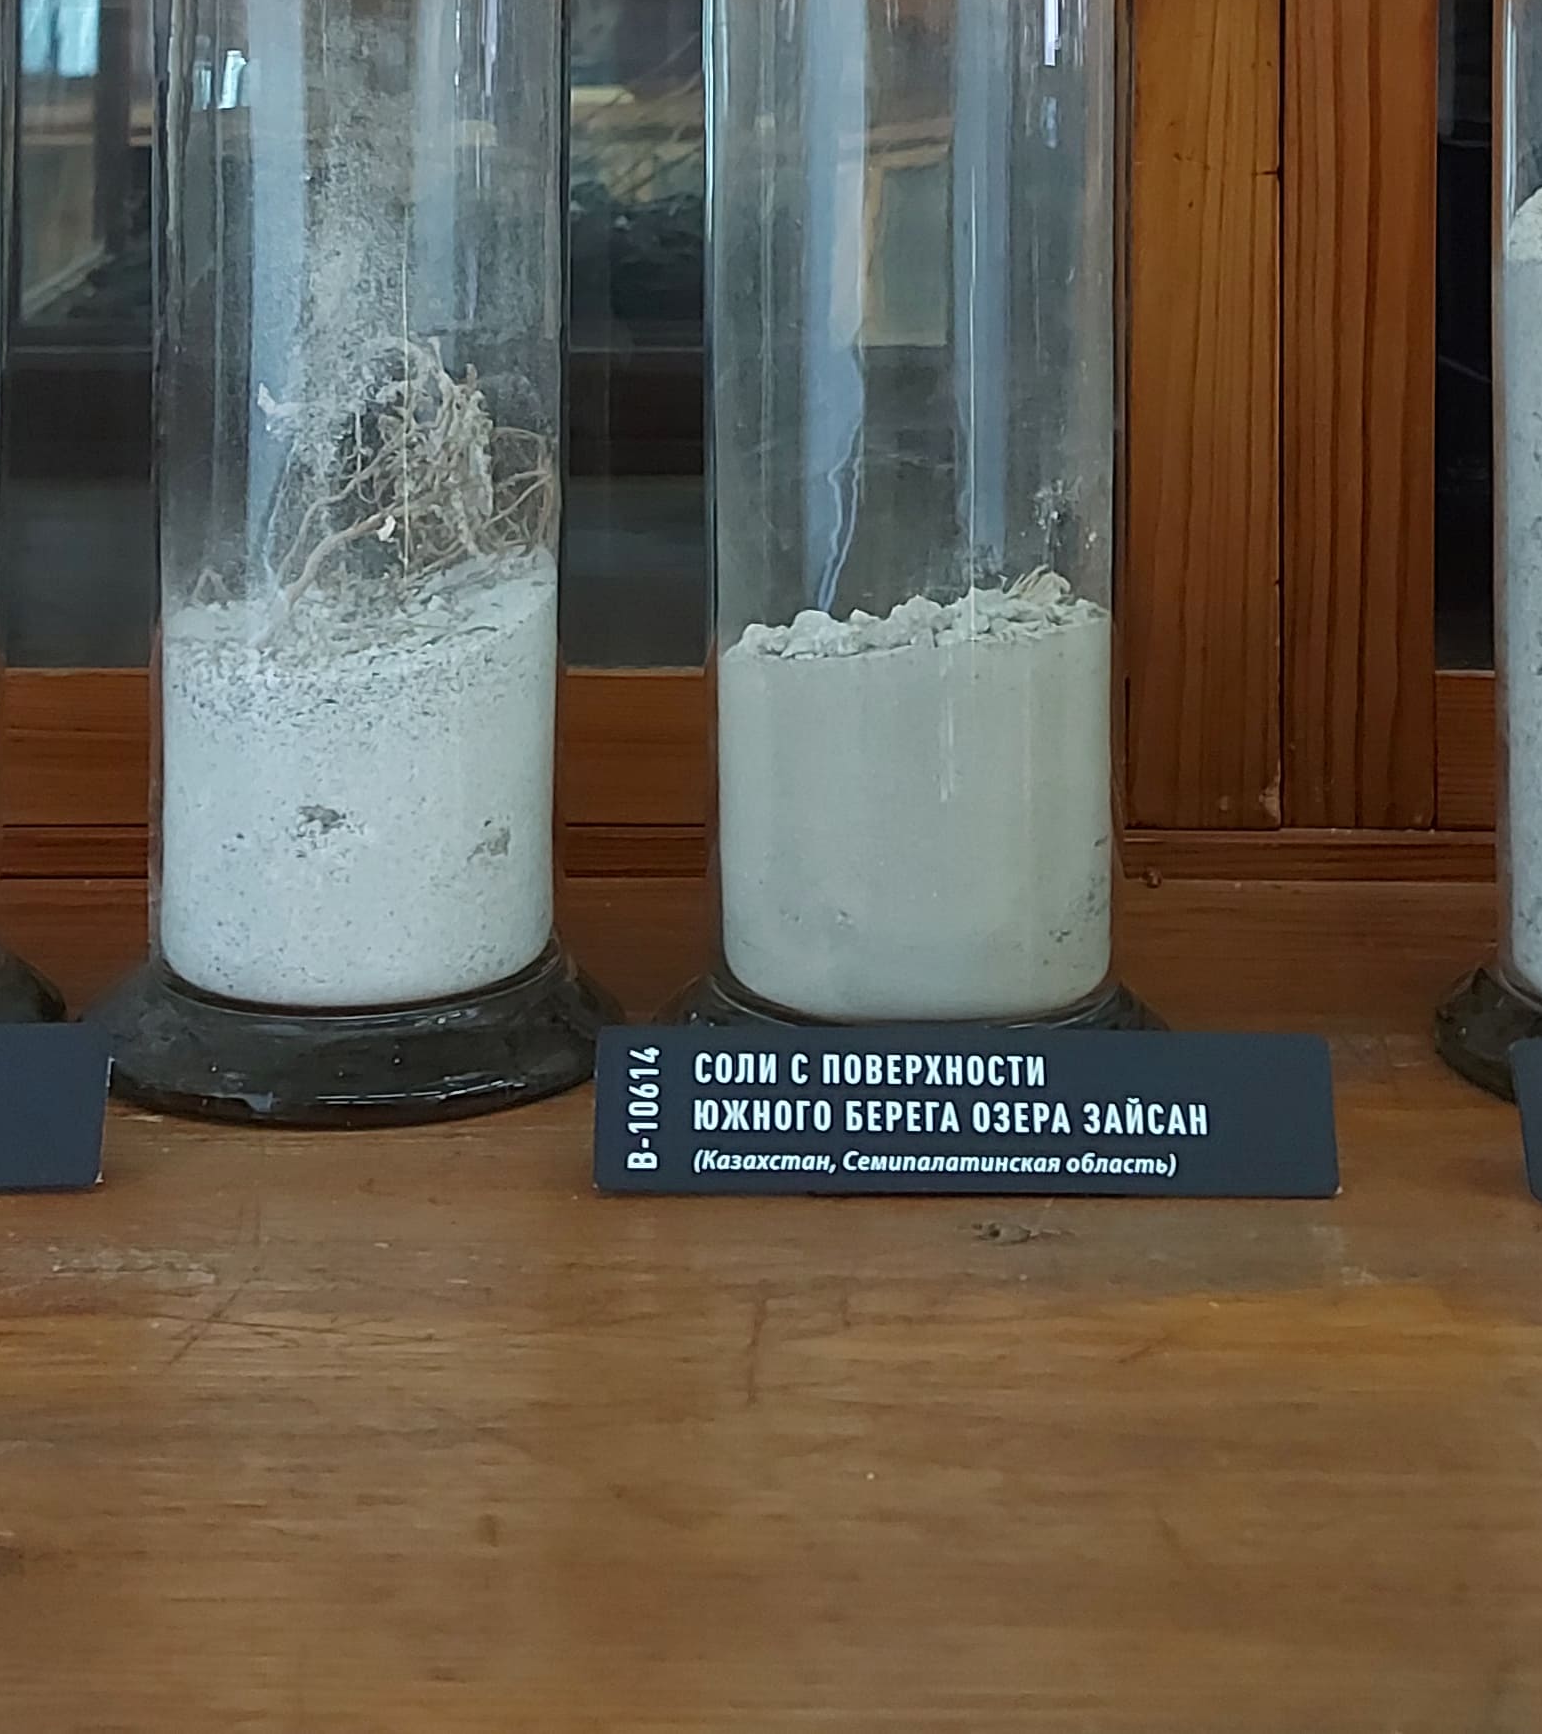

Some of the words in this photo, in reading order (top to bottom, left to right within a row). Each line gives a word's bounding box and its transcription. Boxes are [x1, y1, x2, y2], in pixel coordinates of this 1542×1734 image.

[695, 1053, 776, 1083] СОЛИ
[792, 1054, 808, 1084] С
[823, 1054, 1044, 1086] ПОВЕРХНОСТИ
[627, 1047, 659, 1169] В-10614
[694, 1100, 831, 1131] ЮЖНОГО
[846, 1101, 959, 1132] БЕРЕГА
[973, 1102, 1070, 1133] ОЗЕРА
[1084, 1098, 1207, 1135] ЗАЙСАН
[694, 1149, 836, 1173] (Казахстан,
[843, 1151, 1060, 1172] Семипалатинская
[1066, 1153, 1176, 1177] область)
